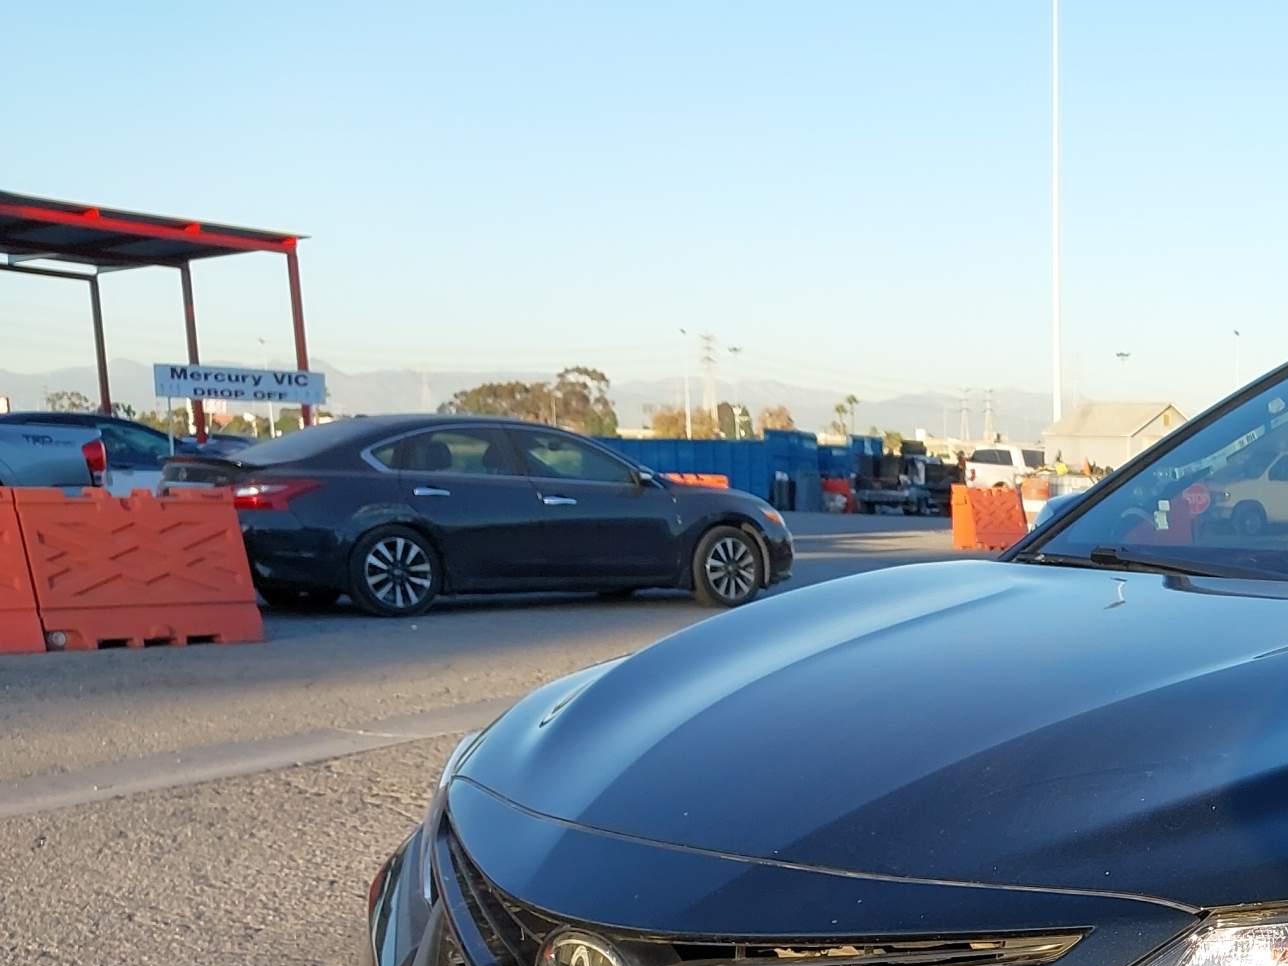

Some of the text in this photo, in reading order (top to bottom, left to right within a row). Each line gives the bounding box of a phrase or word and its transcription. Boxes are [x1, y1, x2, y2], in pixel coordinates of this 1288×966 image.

[170, 367, 309, 386] Mercury VIC
[193, 387, 288, 400] DROP OFF
